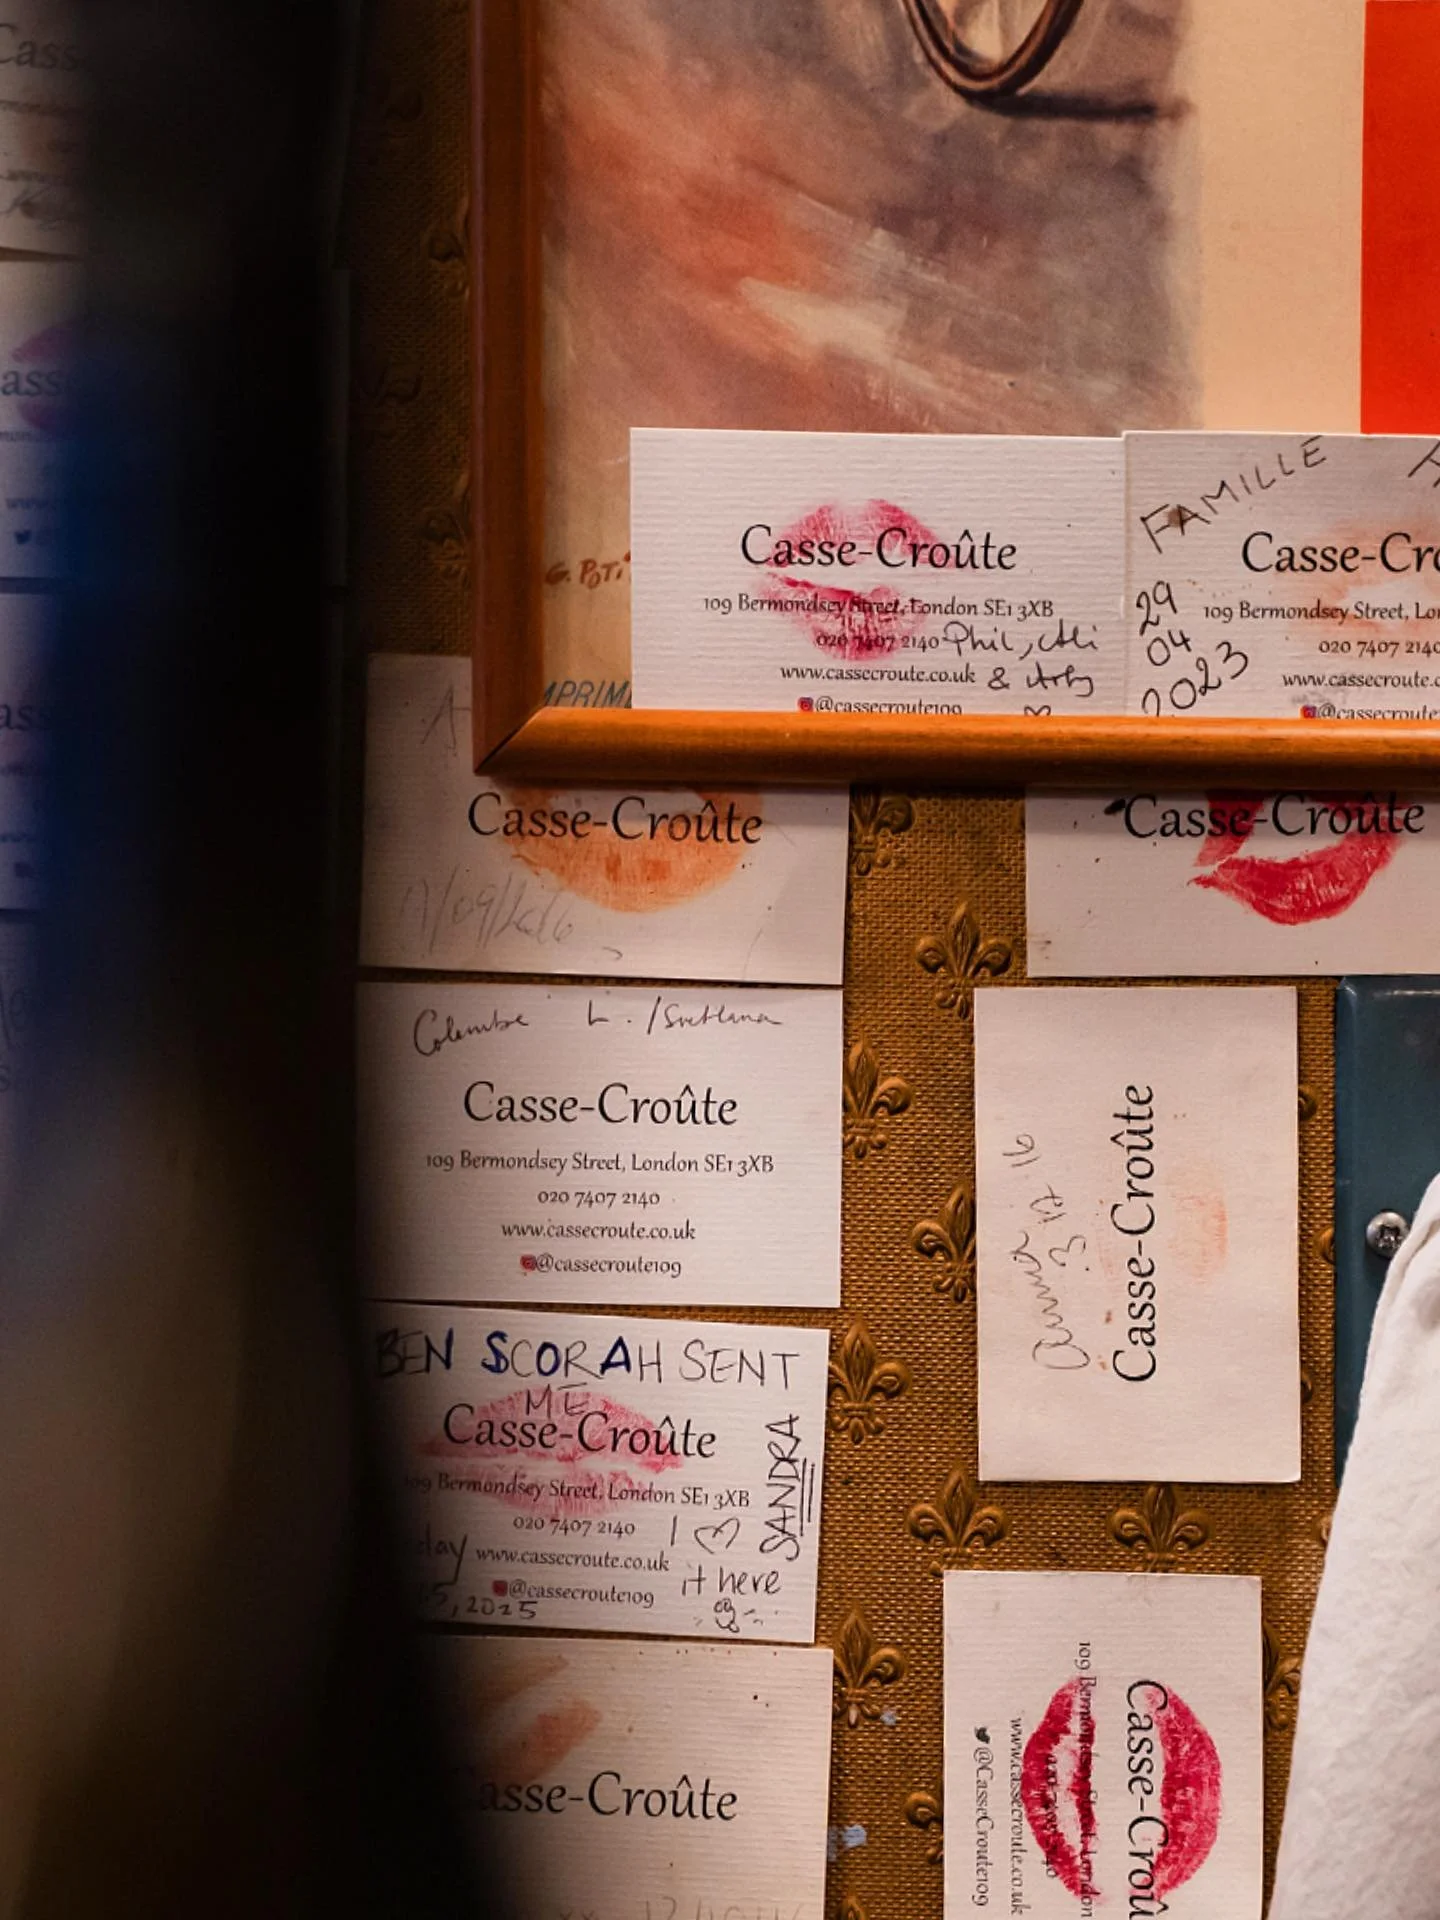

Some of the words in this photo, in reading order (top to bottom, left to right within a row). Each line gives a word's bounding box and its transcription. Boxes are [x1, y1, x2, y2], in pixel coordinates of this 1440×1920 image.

[1139, 434, 1327, 554] FAMILLE
[741, 523, 1017, 571] Casse-Croûte
[704, 598, 732, 615] 109
[738, 593, 847, 618] Bermondsey
[910, 596, 979, 616] London
[983, 599, 1013, 616] SE1
[1016, 600, 1054, 622] 3XB
[1136, 580, 1177, 636] 29
[1204, 603, 1233, 624] 109
[1239, 599, 1349, 628] Bermondsey
[1353, 600, 1409, 622] Street,
[816, 633, 848, 648] 020
[901, 635, 939, 653] 2140
[1147, 629, 1193, 667] 04
[1318, 640, 1351, 655] 020
[1357, 639, 1399, 658] 7407
[781, 662, 976, 684] www.cassecroute.co.uk
[987, 667, 1010, 690] &
[467, 791, 763, 845] Casse-Croûte
[1124, 791, 1426, 840] Casse-Croûte
[463, 1080, 739, 1127] Casse-Croûte
[426, 1155, 455, 1173] 109
[459, 1150, 569, 1177] Bermondsey
[571, 1151, 627, 1174] Street,
[631, 1152, 699, 1174] London
[703, 1156, 733, 1174] SE1
[736, 1155, 775, 1178] 3XB
[537, 1190, 570, 1204] 020
[574, 1189, 617, 1209] 7407
[621, 1190, 660, 1208] 2140
[500, 1218, 696, 1241] www.cassecroute.co.uk
[1110, 1084, 1156, 1383] Casse-Croûte
[536, 1253, 682, 1279] @cassecroute109
[481, 1329, 664, 1384] SCORAH
[679, 1338, 801, 1391] SENT
[525, 1381, 589, 1419] ME
[444, 1403, 717, 1460] Casse-Croûte
[437, 1472, 546, 1504] Bermondsey
[549, 1478, 604, 1502] Street,
[608, 1480, 676, 1505] London
[680, 1485, 709, 1507] SE1
[713, 1488, 751, 1510] 3XB
[759, 1413, 802, 1561] SANDRA
[513, 1516, 545, 1531] 020
[550, 1516, 593, 1537] 7407
[598, 1520, 636, 1540] 2140
[475, 1544, 670, 1573] www.cassecroute.co.uk
[509, 1580, 655, 1610] @cassecroute109
[719, 1566, 782, 1596] here
[1074, 1641, 1092, 1671] 109
[478, 1770, 738, 1822] asse-Croûte
[972, 1747, 995, 1907] @CasseCroute109
[1010, 1718, 1031, 1915] www.cassecroute.co.uk
